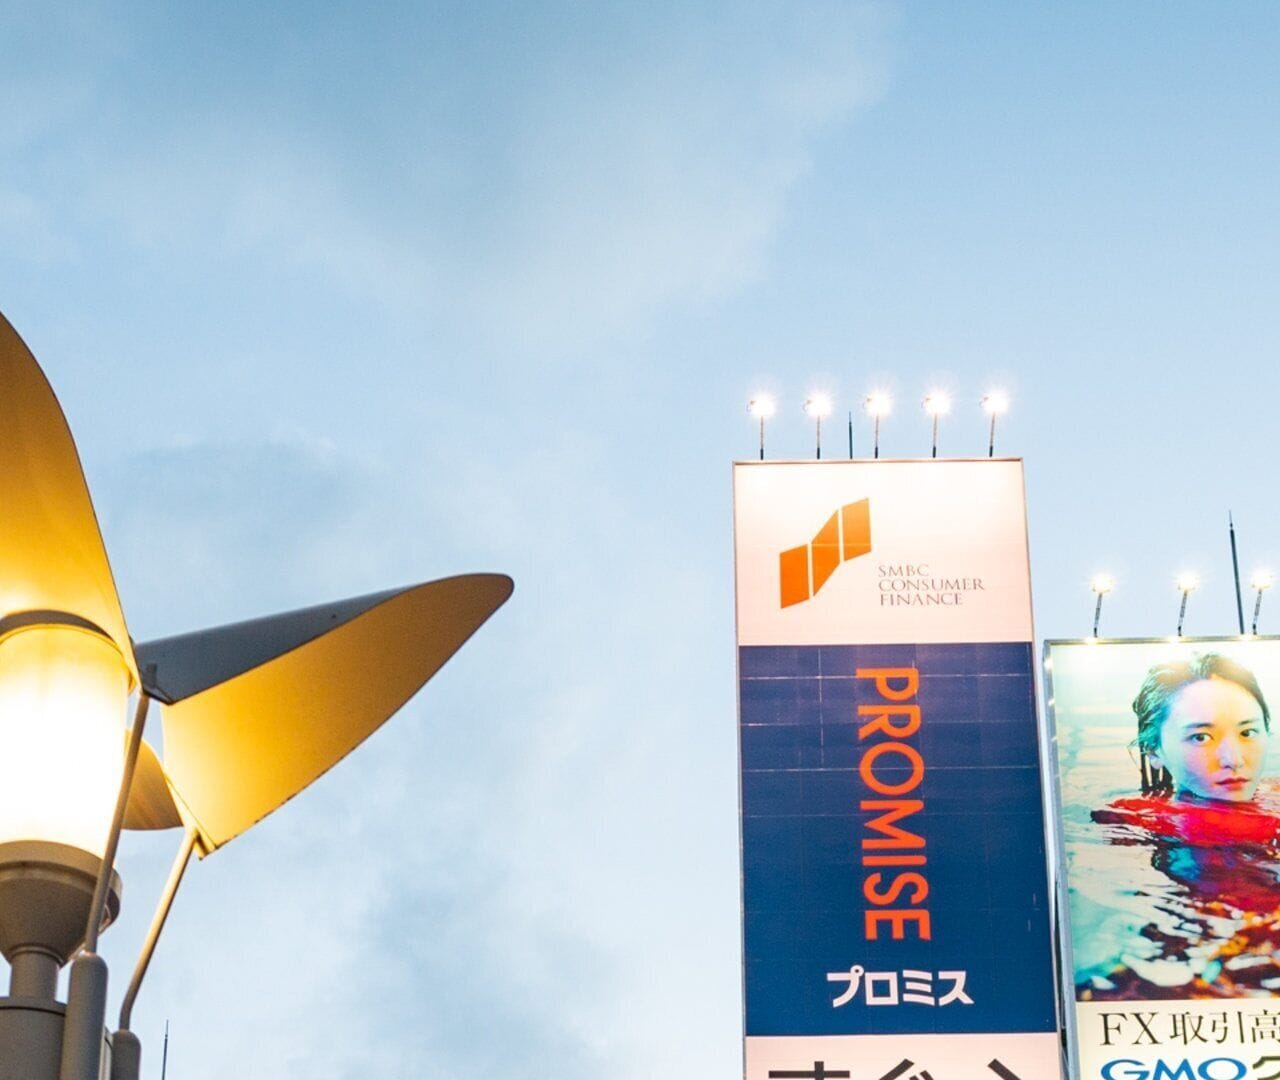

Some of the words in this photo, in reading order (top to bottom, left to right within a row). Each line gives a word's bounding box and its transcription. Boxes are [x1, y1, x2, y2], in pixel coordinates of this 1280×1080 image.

[878, 564, 930, 578] SMBC
[878, 578, 985, 592] CONSUMER
[880, 593, 963, 607] FINANCE
[855, 668, 932, 941] PROMISE
[826, 965, 974, 1008] プロミス
